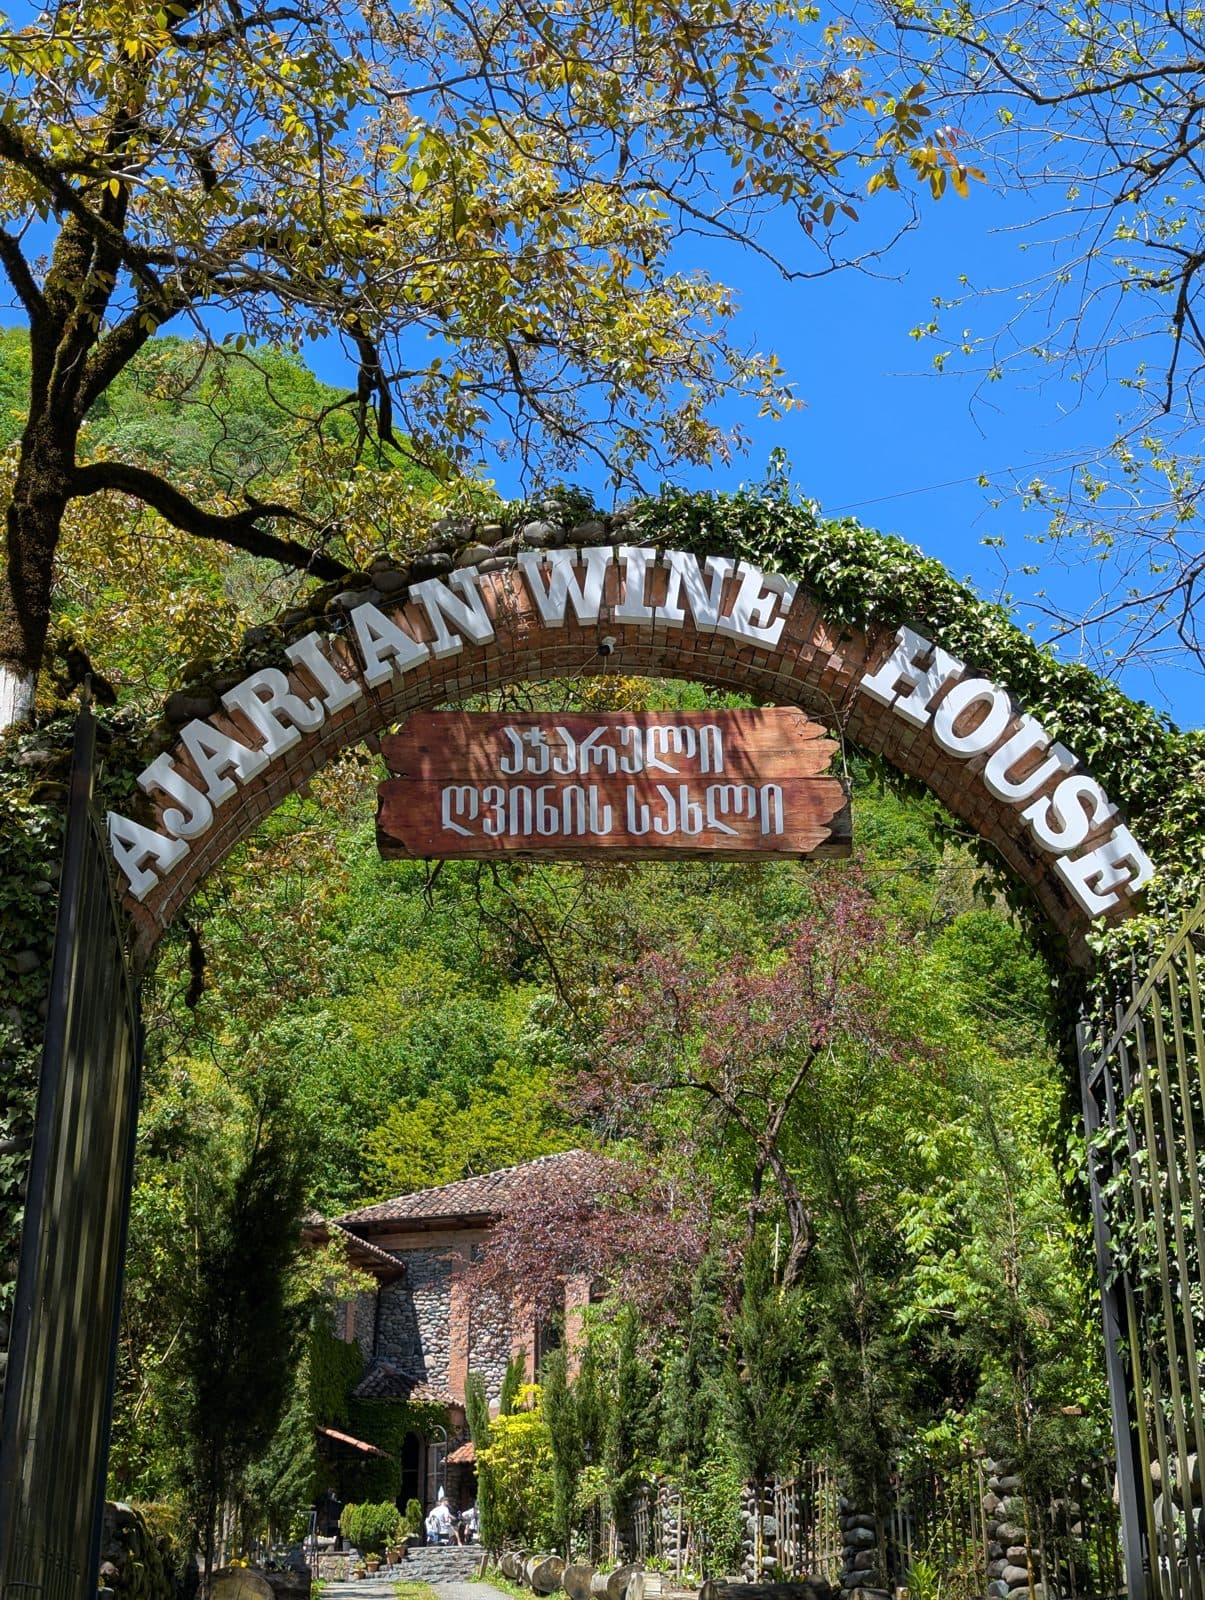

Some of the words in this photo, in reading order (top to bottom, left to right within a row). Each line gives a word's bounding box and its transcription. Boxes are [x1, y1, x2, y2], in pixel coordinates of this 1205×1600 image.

[107, 565, 496, 901] AJARIAN
[517, 546, 798, 650] WINE
[860, 625, 1154, 919] HOUSE
[500, 725, 723, 774] აჭარული
[441, 784, 612, 837] ღვინის
[626, 783, 784, 836] სახლი
